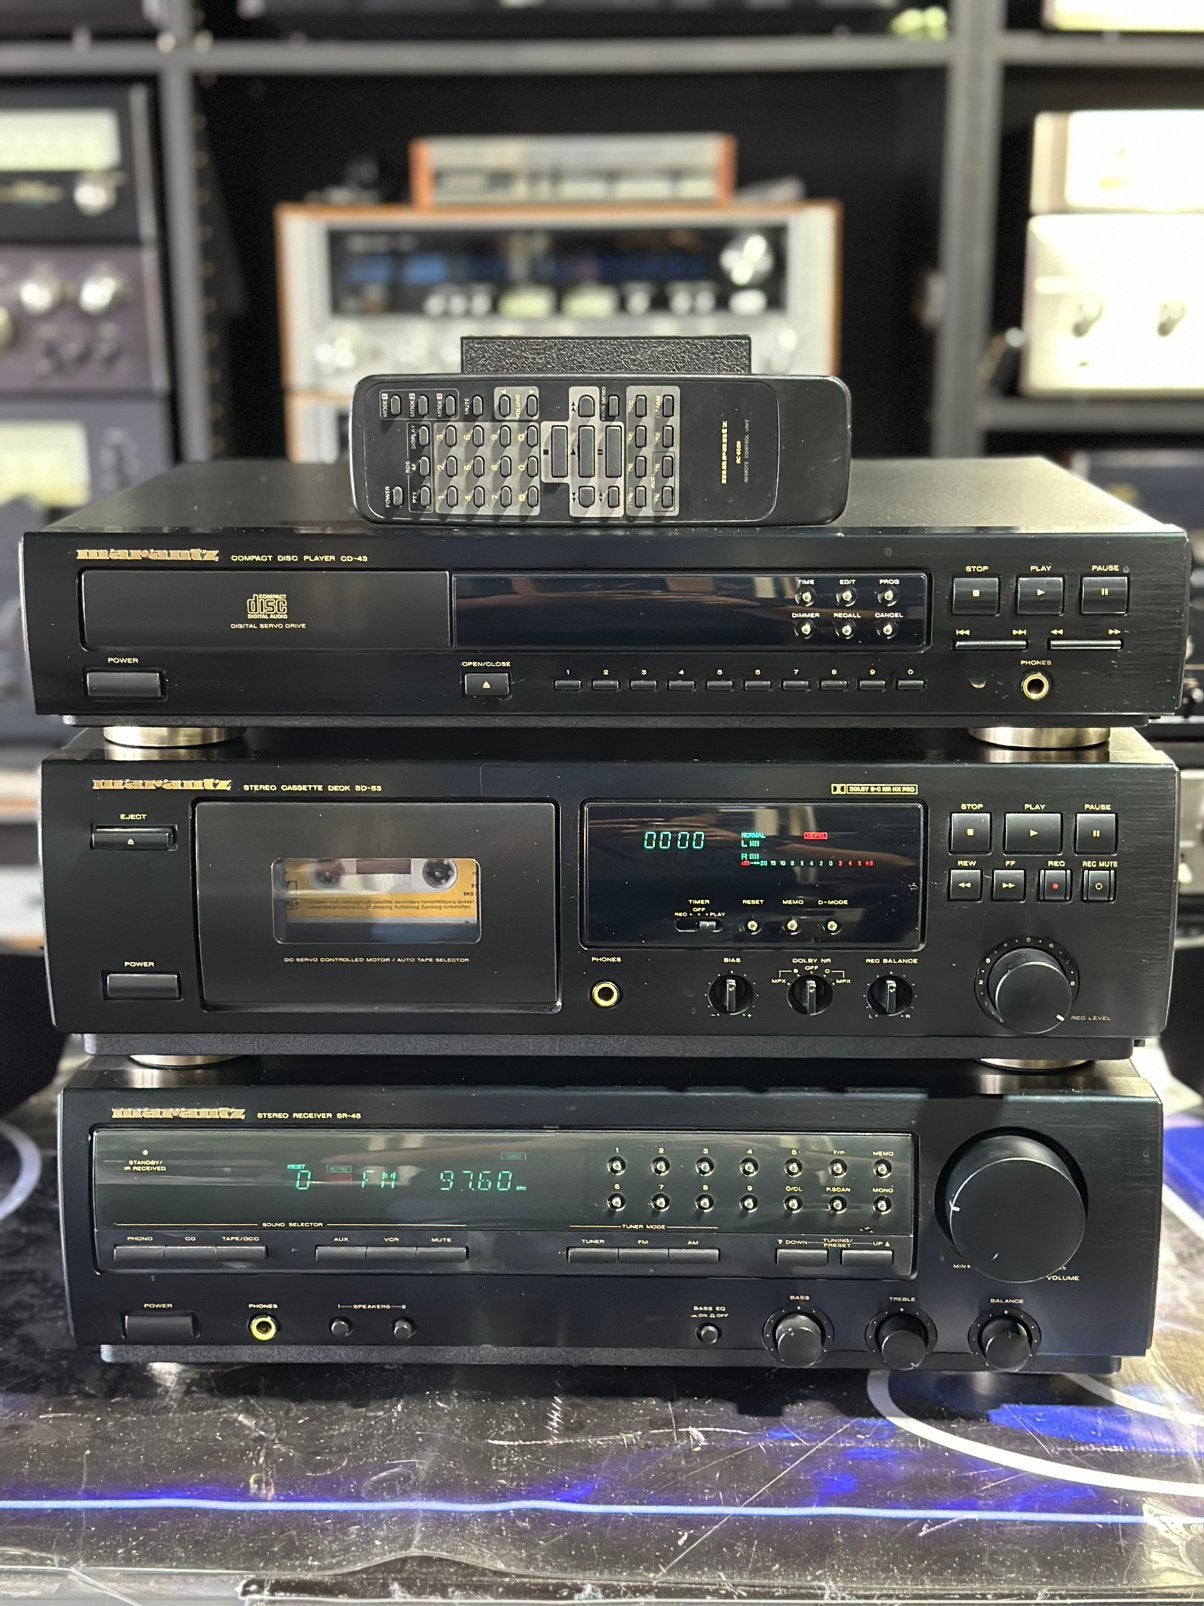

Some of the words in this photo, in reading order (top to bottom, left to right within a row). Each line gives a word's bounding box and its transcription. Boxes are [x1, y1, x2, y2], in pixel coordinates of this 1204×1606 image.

[76, 549, 219, 562] marantz
[1091, 564, 1120, 572] PAUSE
[92, 779, 232, 791] marantz
[243, 784, 277, 792] STEREO
[281, 784, 323, 792] CASSETTE
[328, 784, 351, 792] DECK
[111, 1107, 246, 1120] marantz
